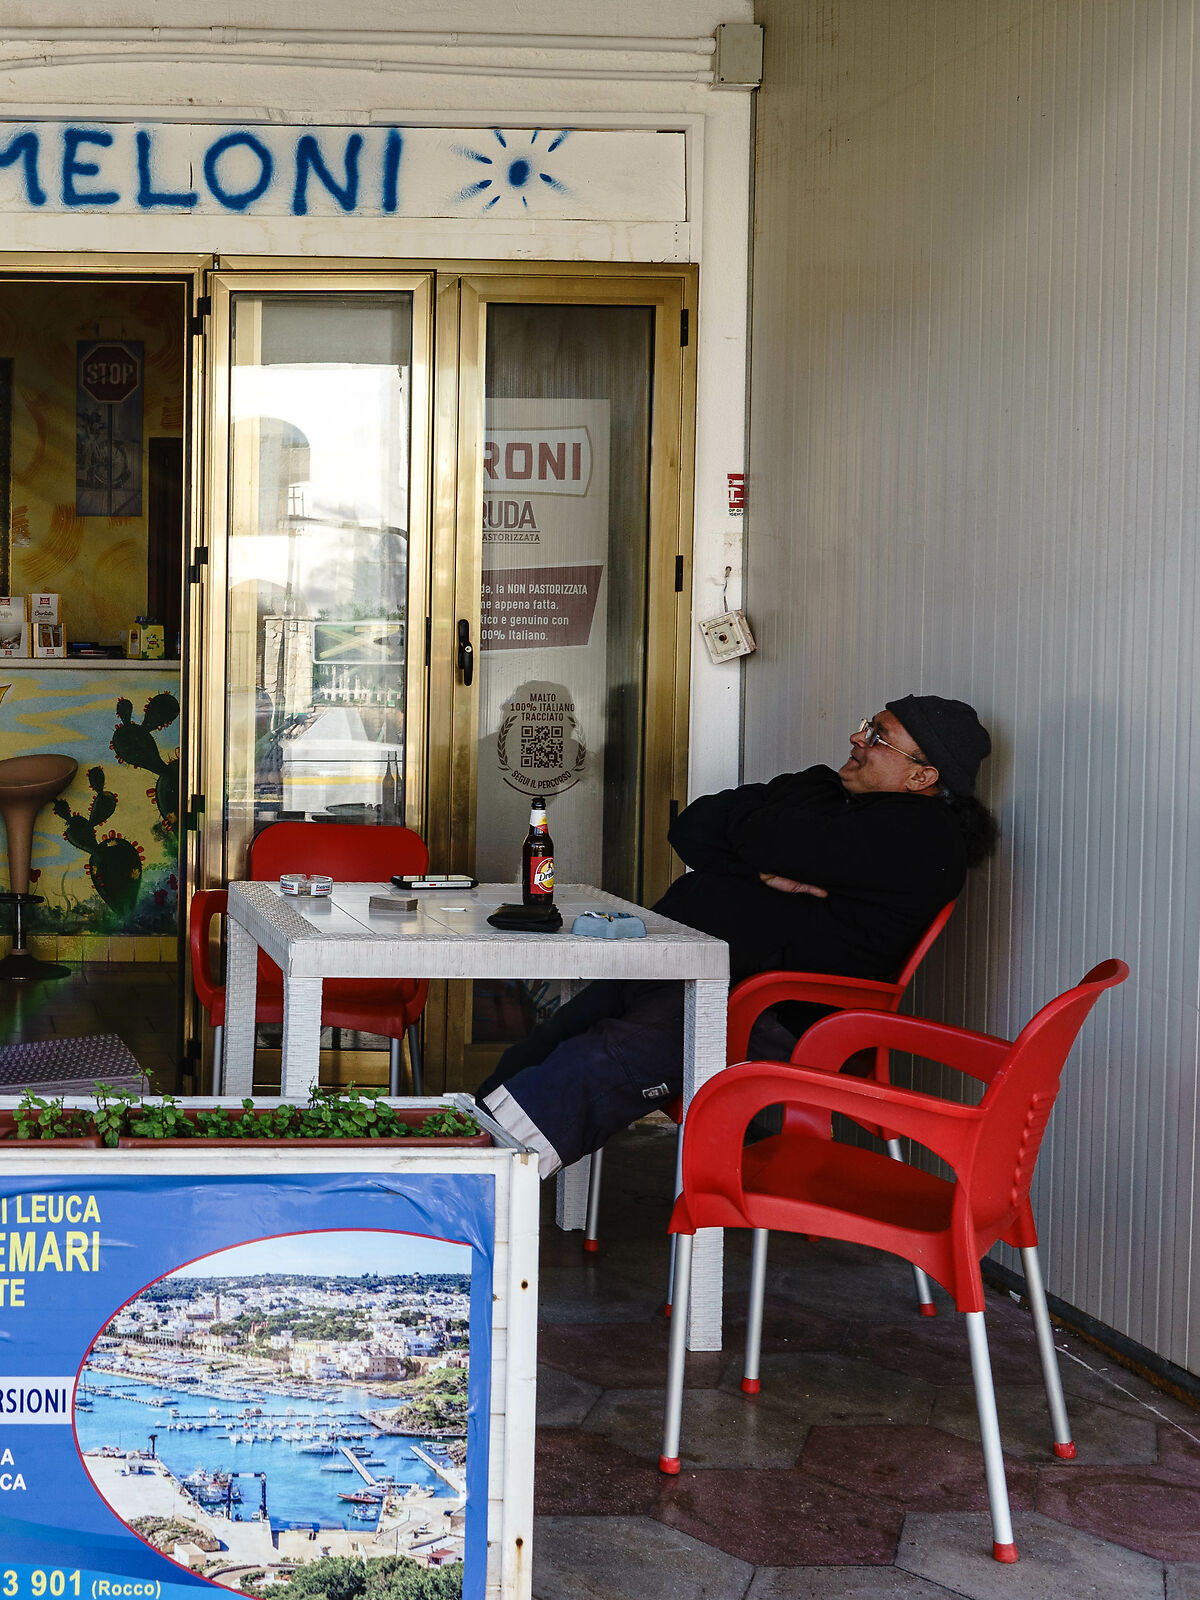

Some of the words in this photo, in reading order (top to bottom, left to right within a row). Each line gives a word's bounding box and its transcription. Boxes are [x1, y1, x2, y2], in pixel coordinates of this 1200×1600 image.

[87, 362, 134, 385] STOP
[496, 584, 505, 594] la
[507, 584, 526, 594] NON
[528, 584, 588, 595] PASTORIZZATA
[495, 601, 530, 612] appena
[533, 600, 559, 610] fatta.
[501, 616, 507, 625] e
[510, 615, 549, 627] genuino
[551, 616, 569, 625] con
[480, 630, 506, 640] 00%
[508, 630, 549, 641] Italiano.
[529, 693, 557, 702] MALTO
[510, 702, 537, 712] 100%
[539, 702, 575, 712] ITALIANO
[521, 712, 564, 722] TRACCIATO
[511, 770, 531, 787] SEGUI
[537, 770, 572, 789] PERCORSO
[16, 1195, 101, 1224] LEUCA
[31, 1569, 82, 1597] 901
[91, 1579, 162, 1600] (Rocco)
